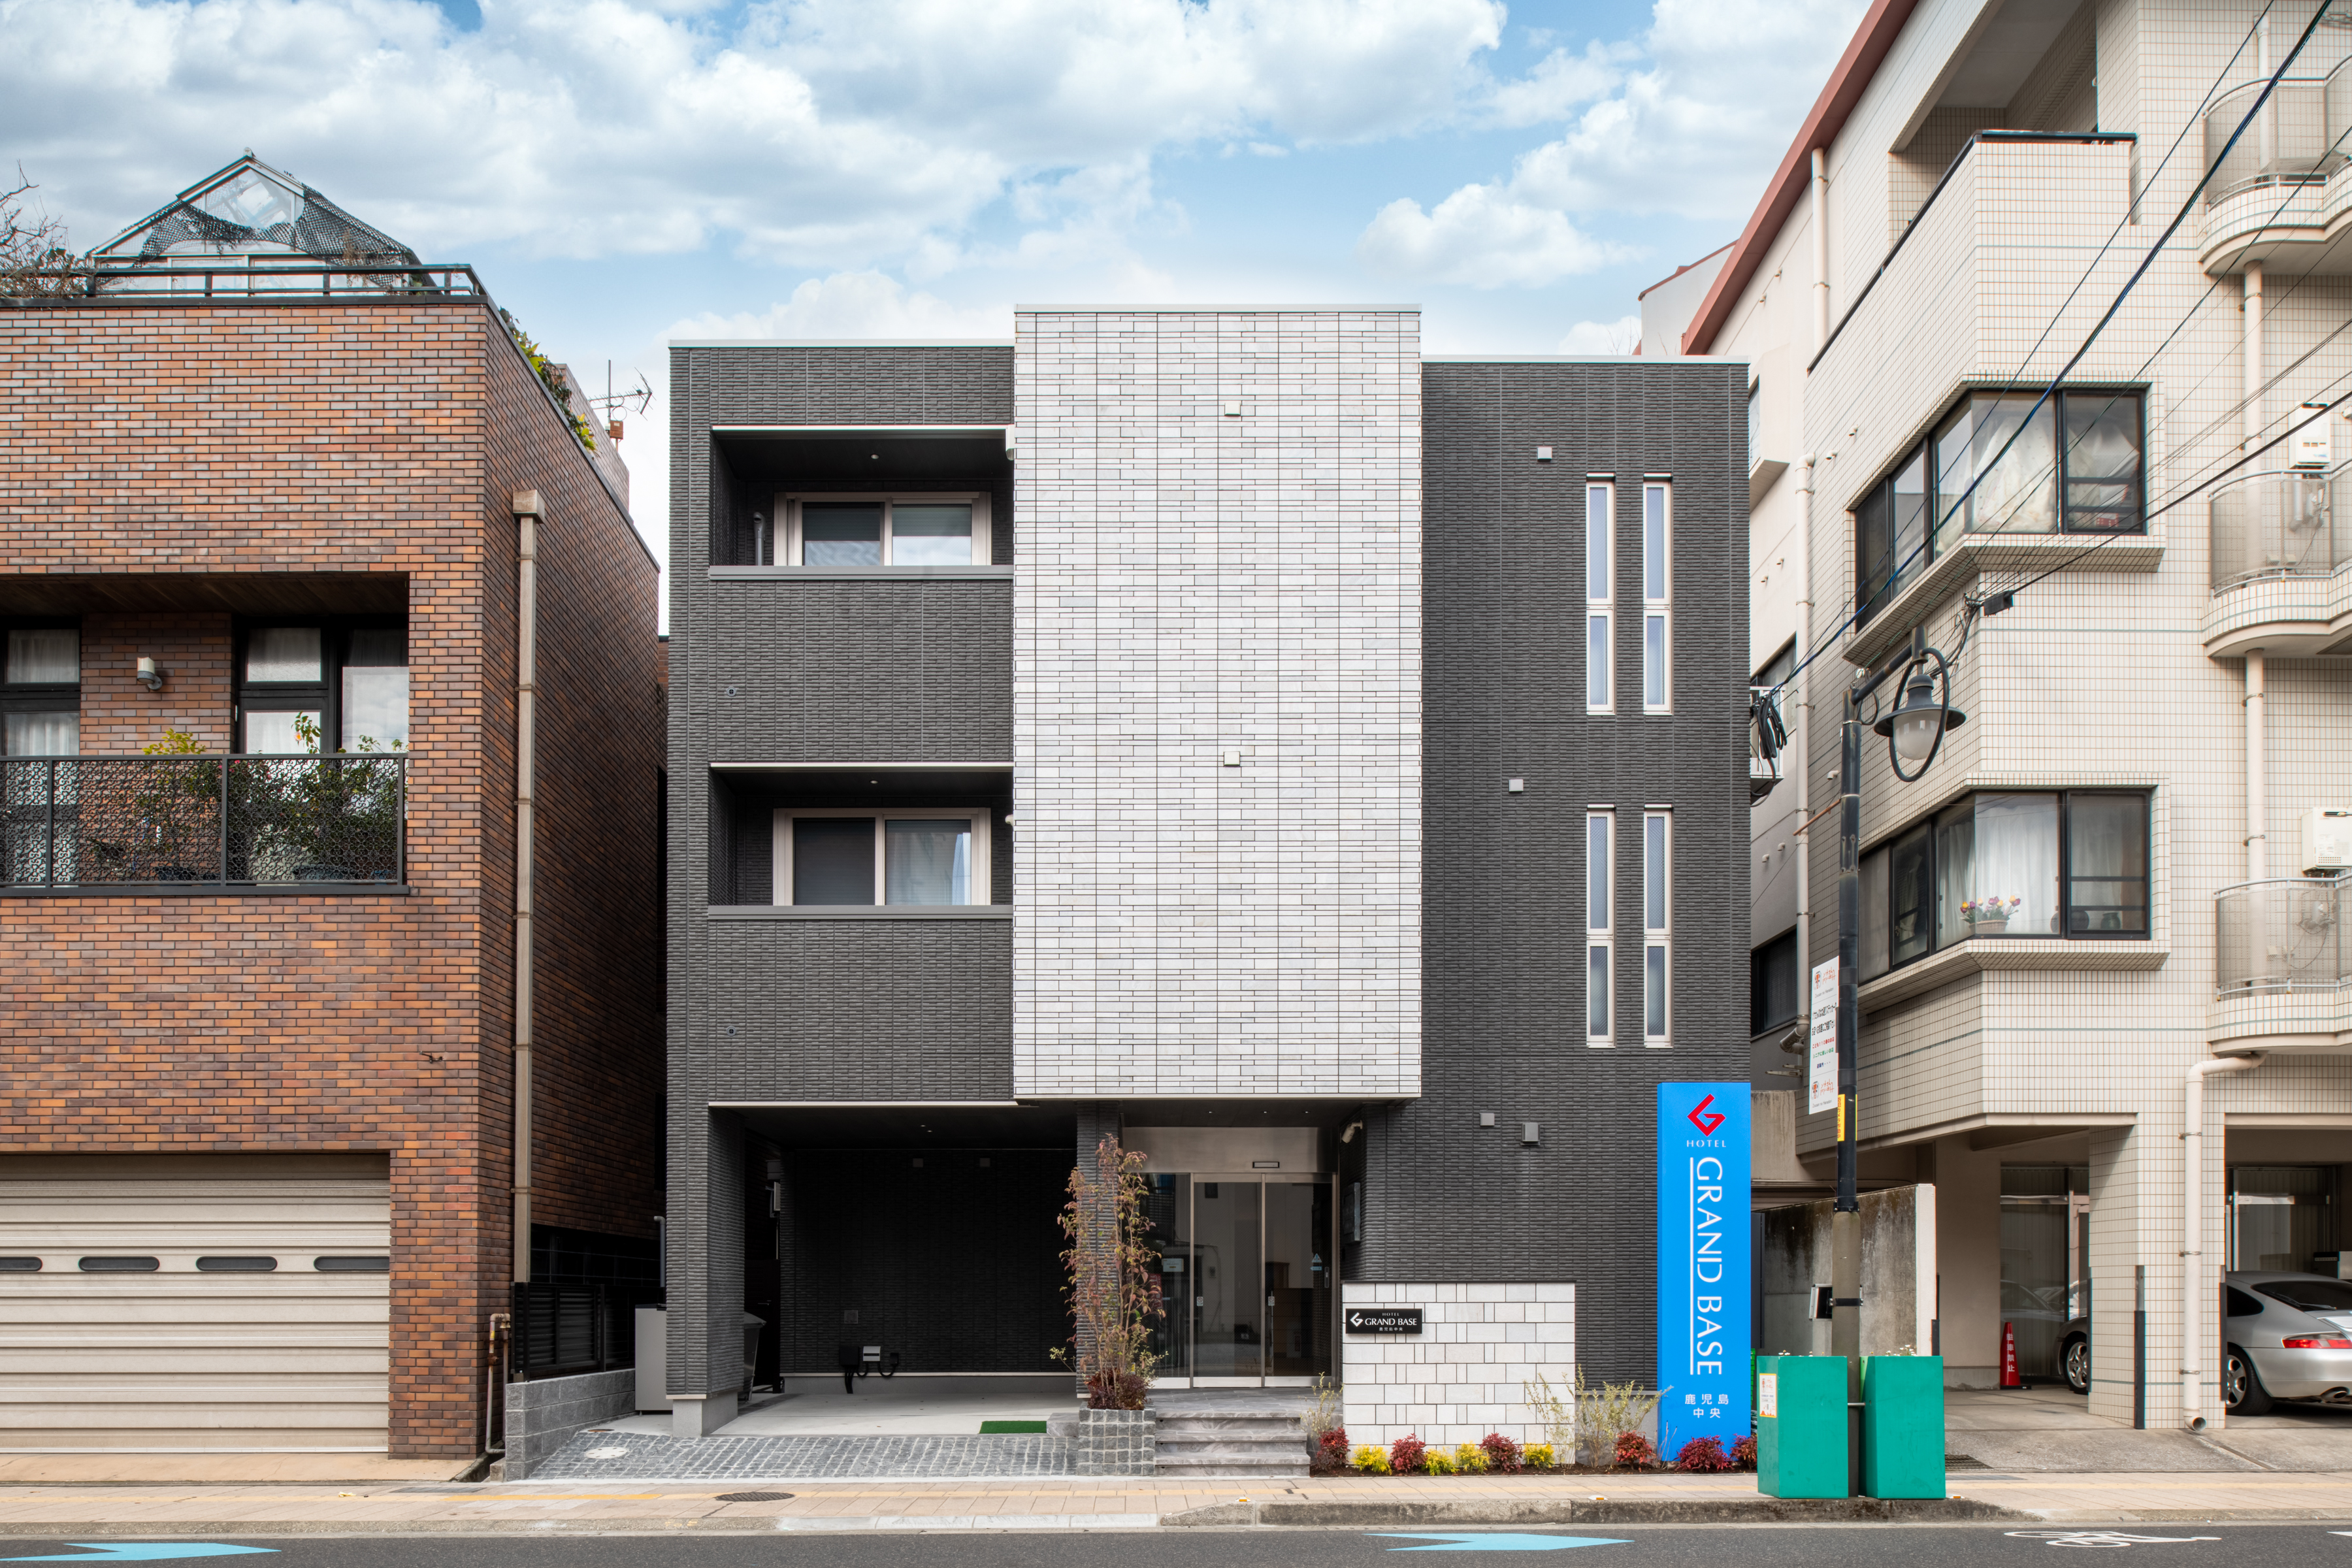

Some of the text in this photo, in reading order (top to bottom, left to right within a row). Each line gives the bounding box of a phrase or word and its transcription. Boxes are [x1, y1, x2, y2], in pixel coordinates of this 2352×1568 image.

[1697, 1156, 1723, 1375] GRAND BASE
[2006, 1333, 2015, 1372] 駐車禁止
[1685, 1394, 1729, 1405] 鹿児島
[1693, 1407, 1720, 1418] 中央
